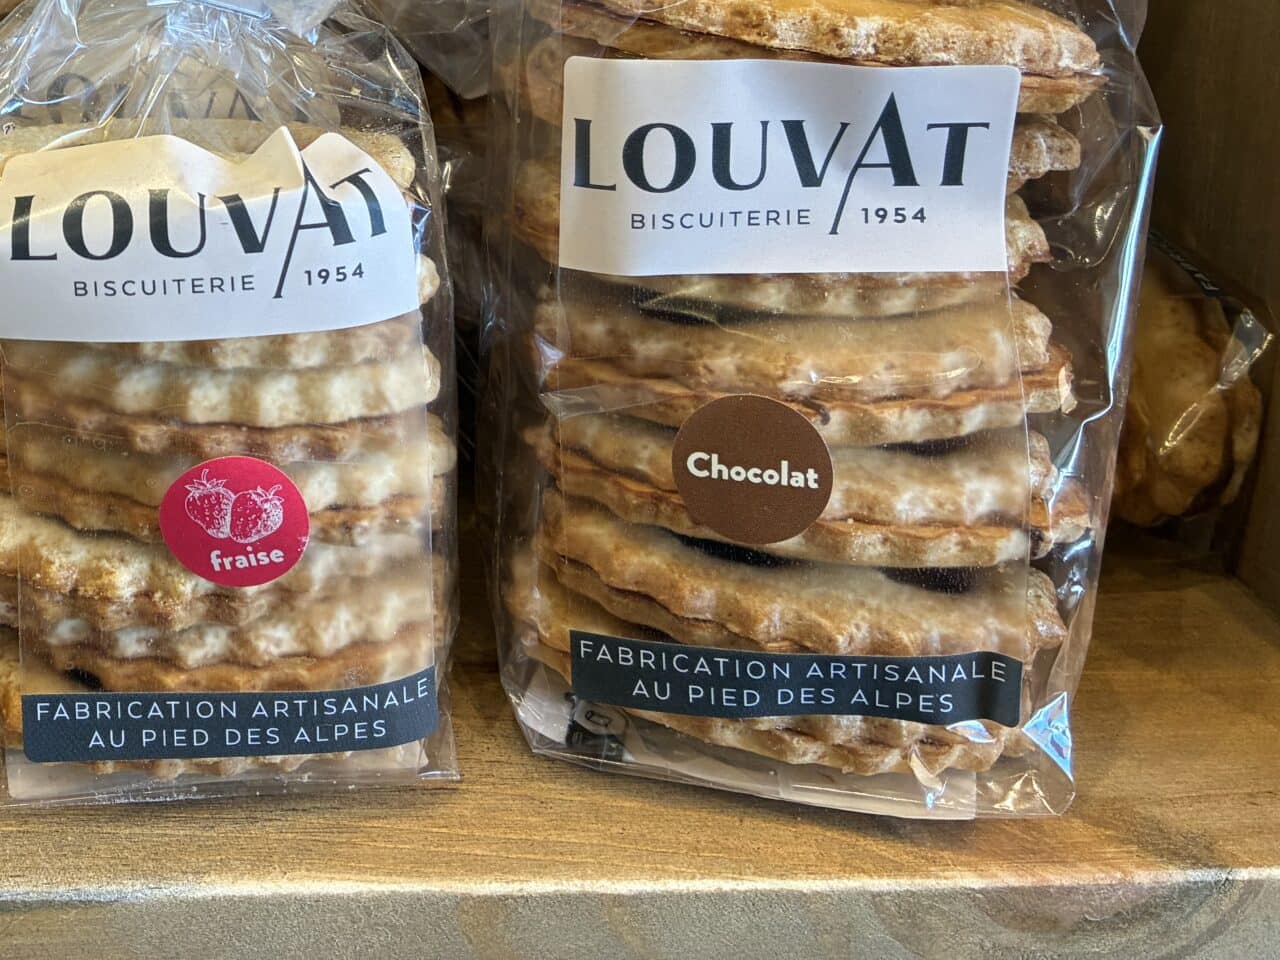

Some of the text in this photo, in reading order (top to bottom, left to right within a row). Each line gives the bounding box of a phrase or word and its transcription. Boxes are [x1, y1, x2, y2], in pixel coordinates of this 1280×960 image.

[573, 92, 990, 235] LOUVAT
[10, 160, 388, 299] LOUVAT
[630, 207, 927, 230] BISCUITERIE 1954
[73, 262, 365, 297] BISCUITERIE 1954
[686, 451, 819, 489] Chocolat
[210, 545, 285, 572] fraise
[579, 641, 1007, 684] FABRICATION ARTISANALE
[36, 677, 429, 722] FABRICATION ARTISANALE
[632, 680, 954, 713] AU PIED DES ALPES
[88, 719, 387, 749] AU PIED DES ALPES
